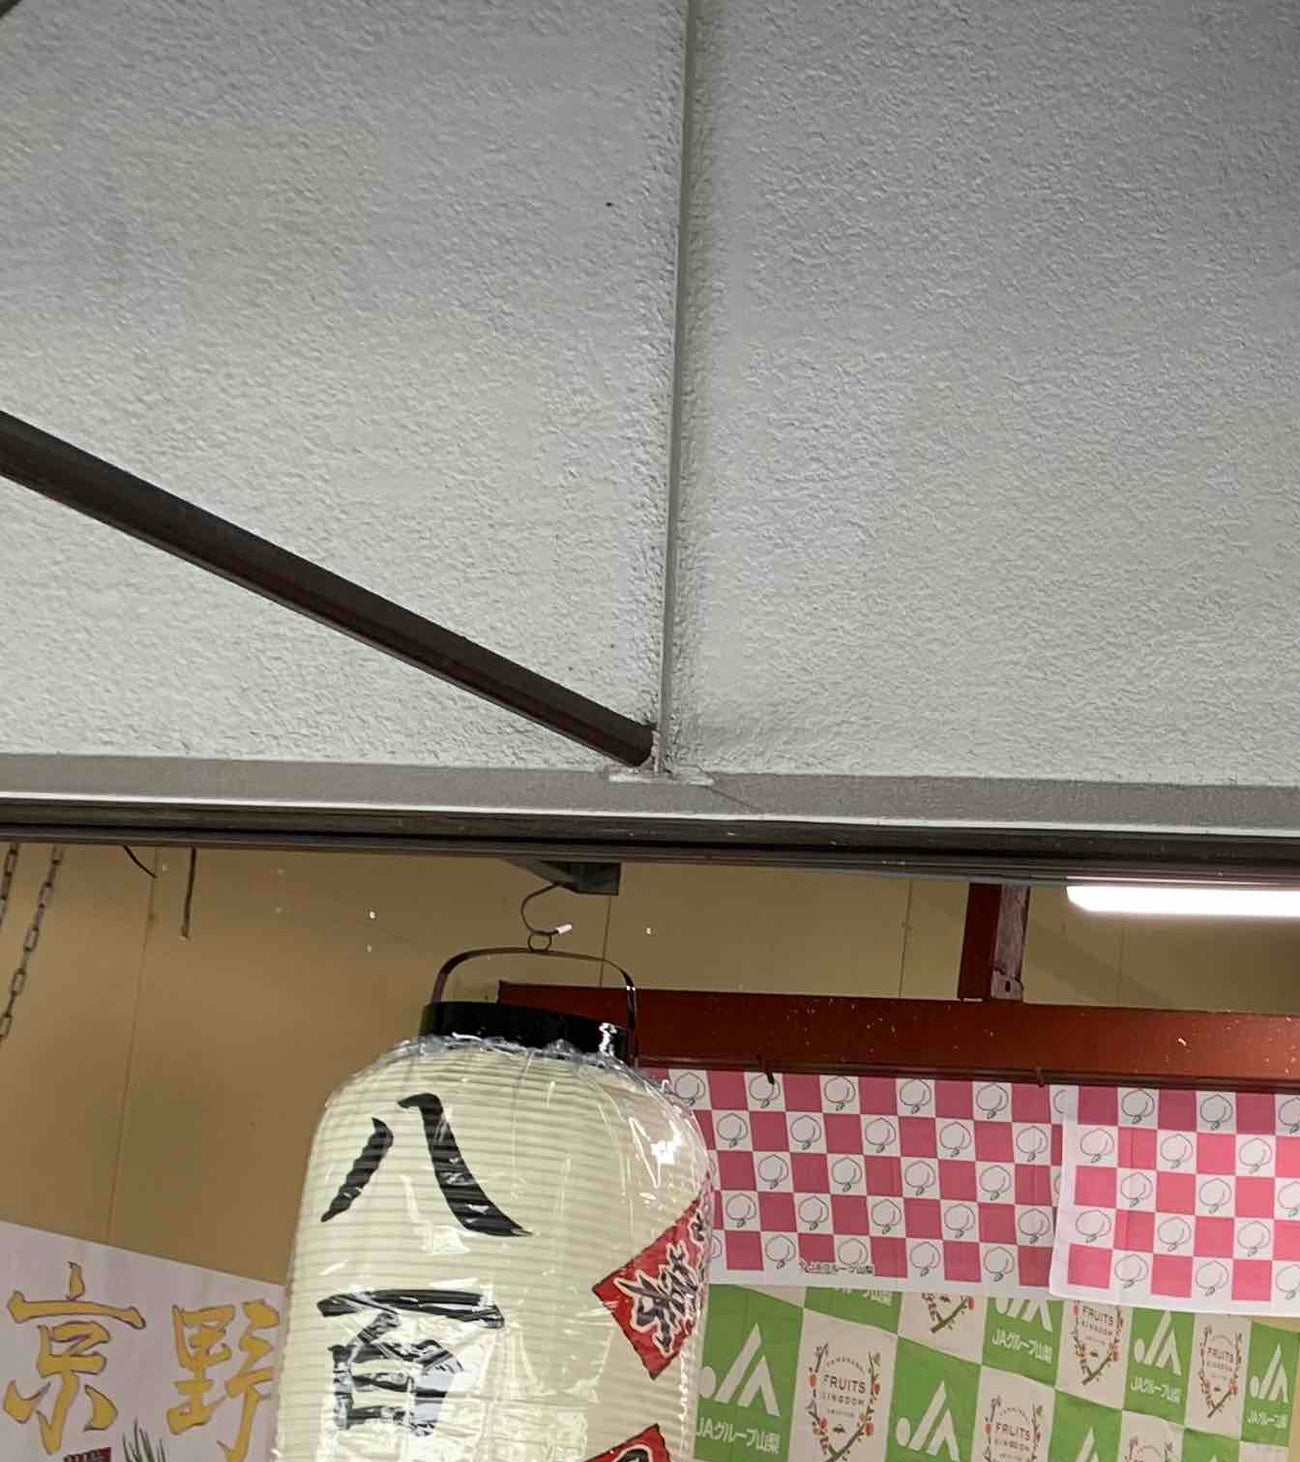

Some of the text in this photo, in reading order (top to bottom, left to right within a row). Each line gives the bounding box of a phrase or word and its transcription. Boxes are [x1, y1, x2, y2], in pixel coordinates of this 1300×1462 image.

[1082, 1305, 1114, 1325] FRUITS
[822, 1373, 866, 1395] FRUITS
[695, 1416, 782, 1455] JAグループ山梨
[994, 1423, 1031, 1441] FRUITS
